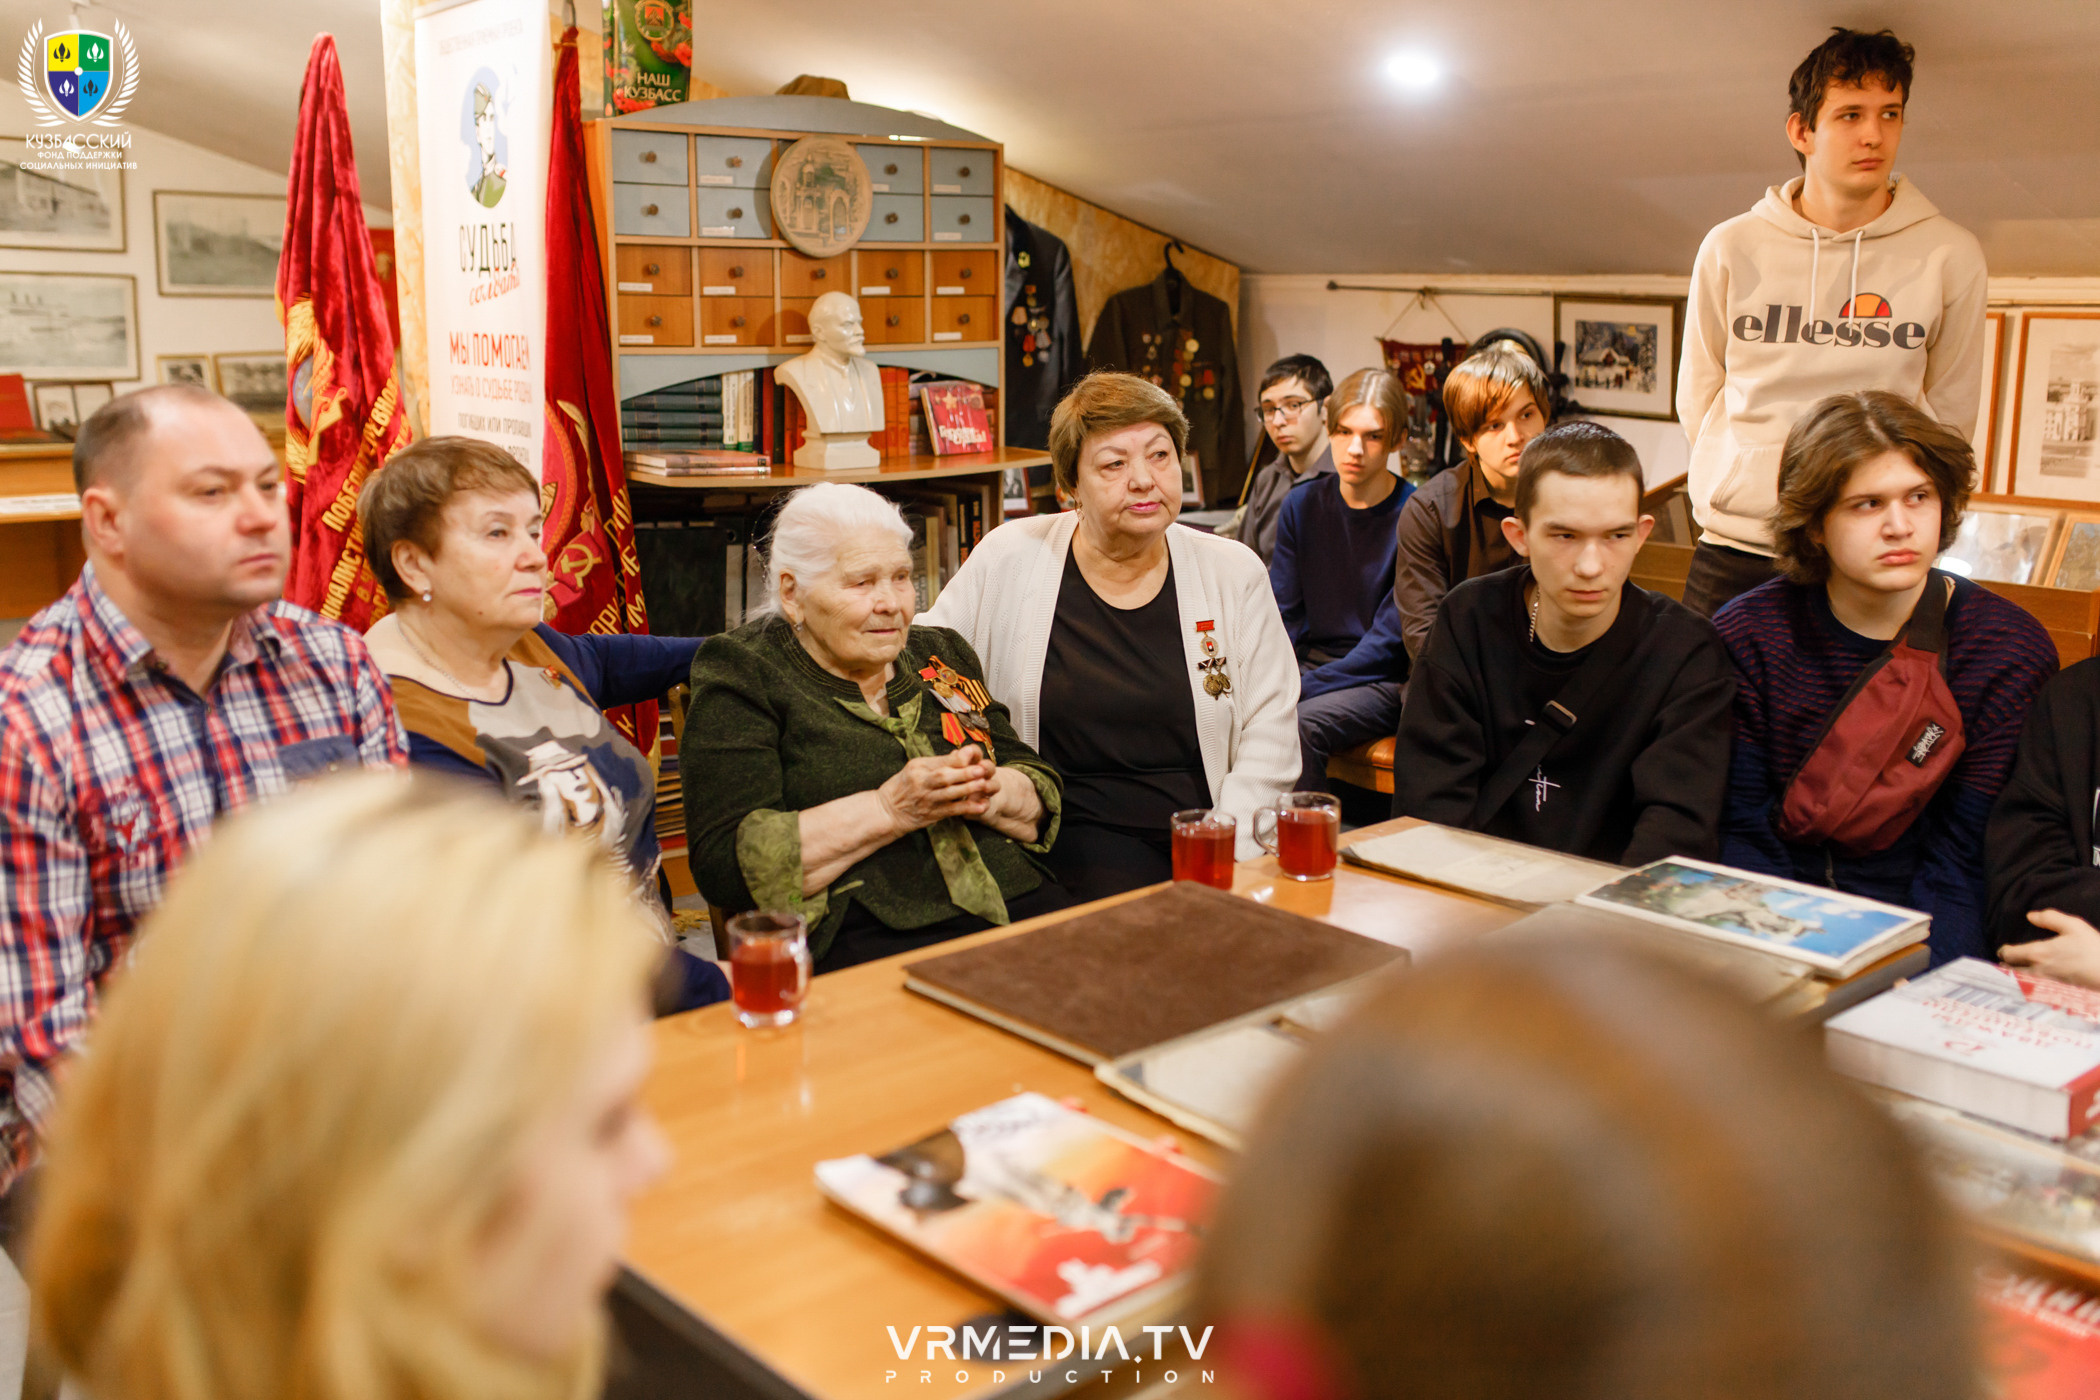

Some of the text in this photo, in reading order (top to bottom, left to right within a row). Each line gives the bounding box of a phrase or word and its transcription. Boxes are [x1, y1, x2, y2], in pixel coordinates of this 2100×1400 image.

[623, 85, 682, 102] КУЗБАСС
[637, 72, 671, 87] НАШ
[459, 221, 518, 278] СУДЬБА
[1732, 303, 1926, 350] ellesse
[449, 330, 470, 366] МЫ
